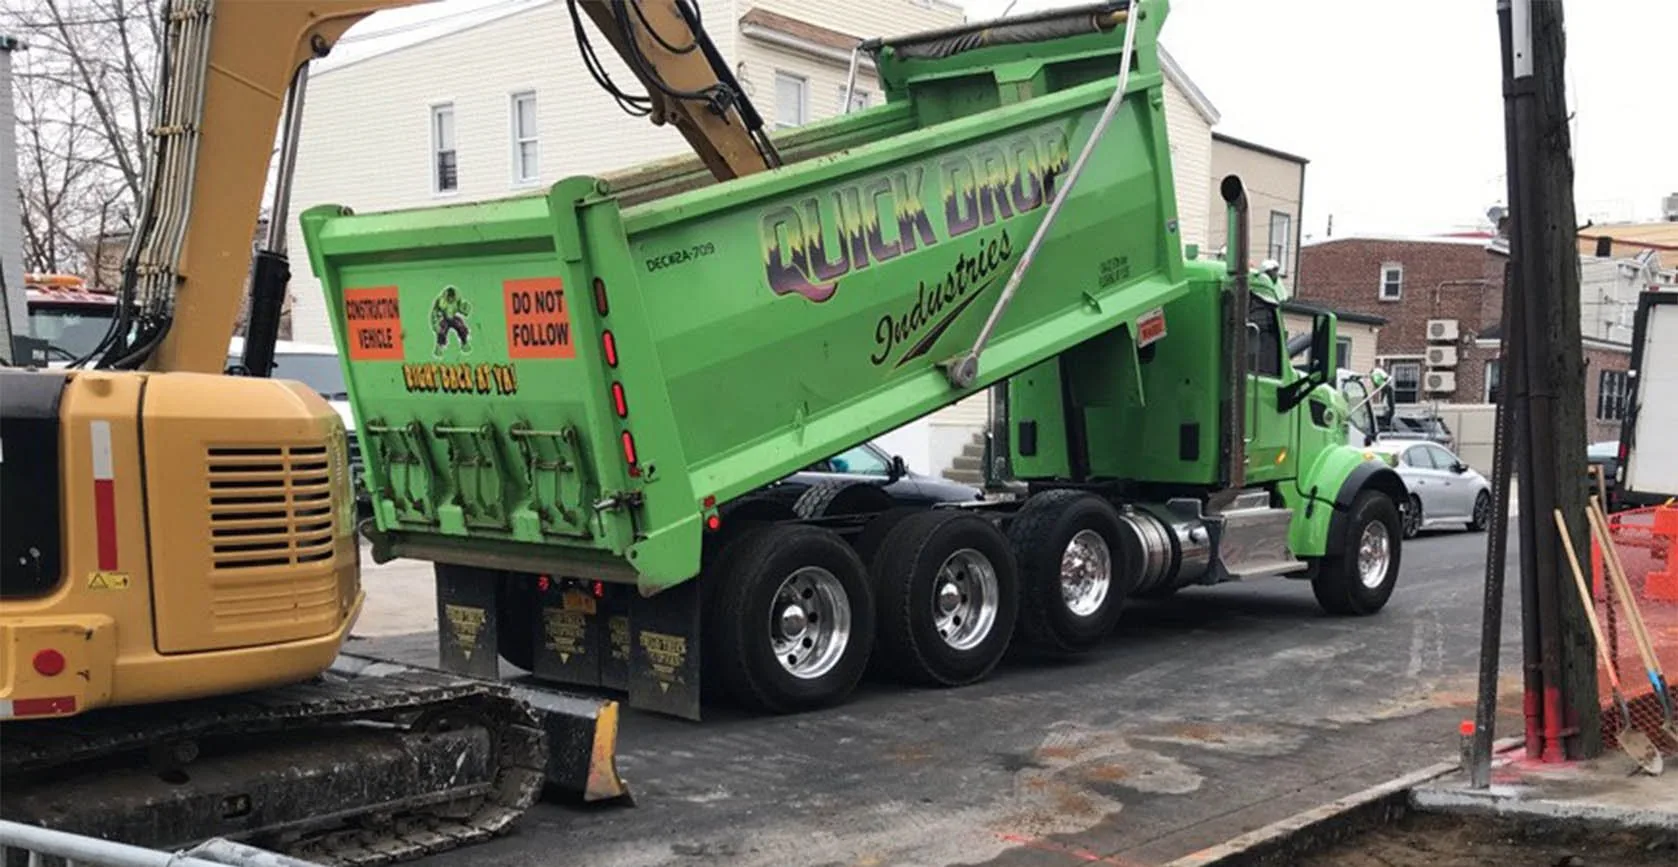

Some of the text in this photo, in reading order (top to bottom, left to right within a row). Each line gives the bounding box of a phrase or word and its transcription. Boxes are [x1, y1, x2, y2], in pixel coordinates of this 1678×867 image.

[760, 124, 1071, 303] QUICK DROP
[346, 297, 400, 321] CONSTRUCTION
[511, 289, 564, 314] DO NOT
[871, 228, 1014, 367] Industries
[358, 327, 393, 350] VEHICLE
[512, 322, 570, 347] FOLLOW
[439, 363, 474, 395] BACK
